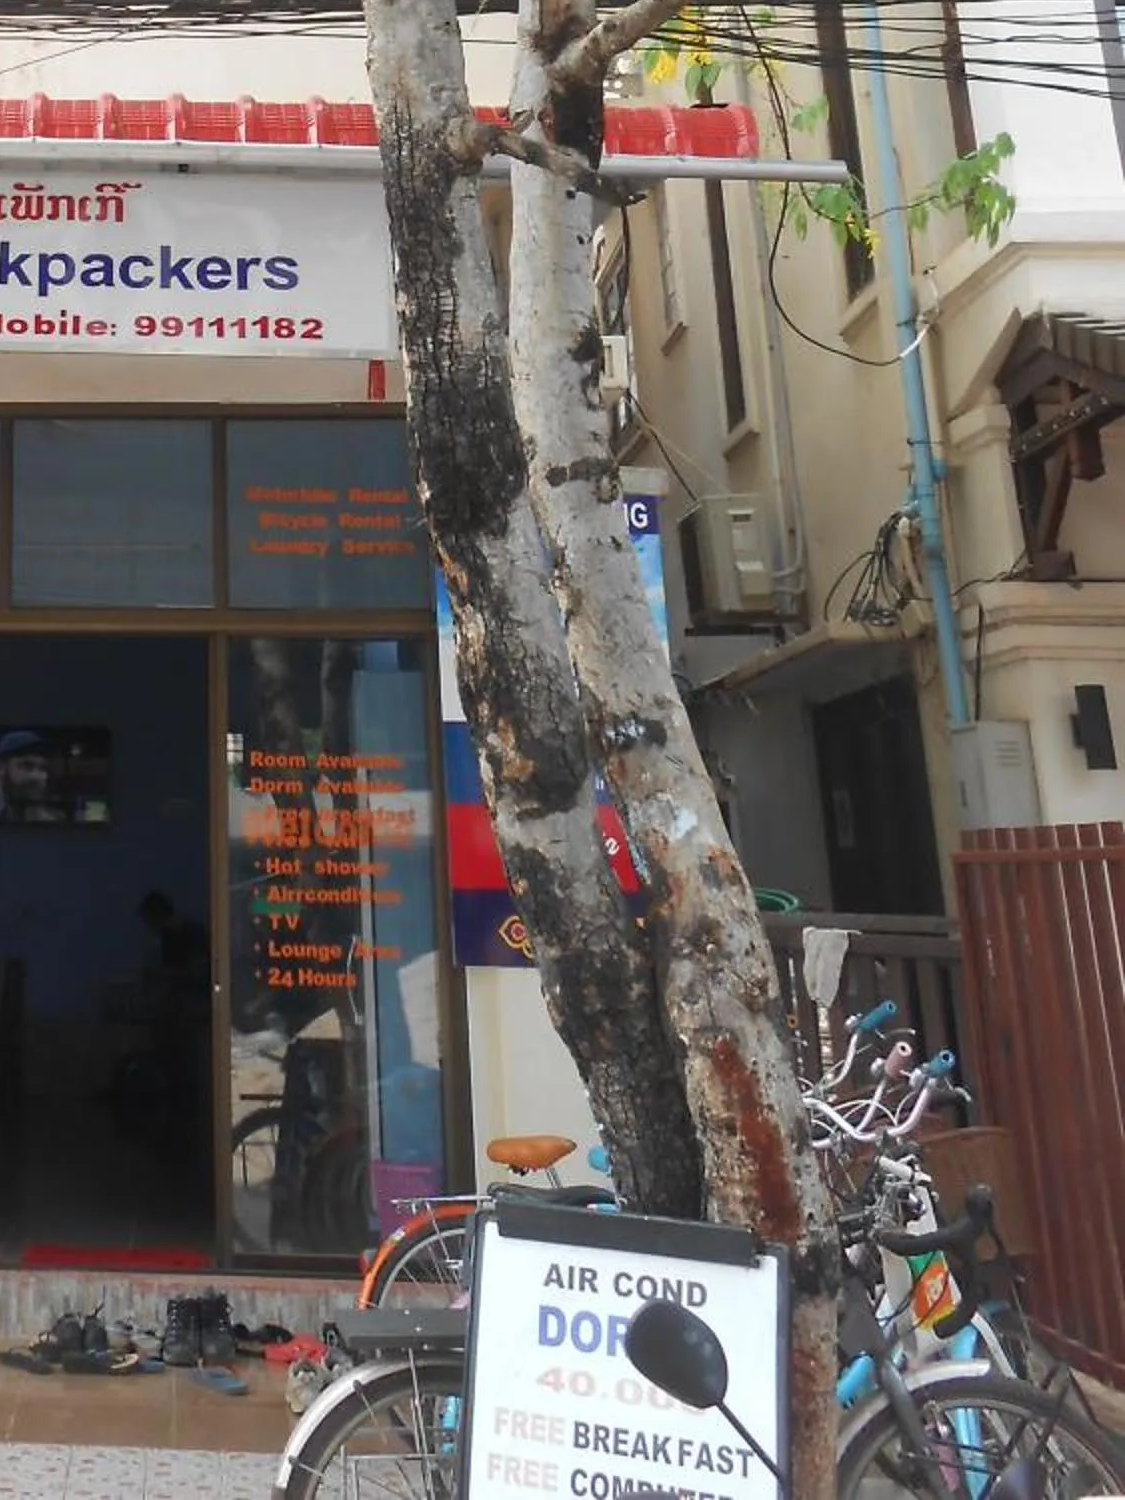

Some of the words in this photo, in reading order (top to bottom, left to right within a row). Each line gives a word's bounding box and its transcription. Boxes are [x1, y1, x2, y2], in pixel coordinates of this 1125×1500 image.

[134, 315, 323, 340] 99111182
[250, 751, 306, 768] Room
[251, 777, 303, 794] Dorm
[266, 857, 301, 875] Hot
[268, 941, 343, 962] Lounge
[267, 970, 293, 987] 24
[298, 969, 357, 987] Hours
[543, 1263, 599, 1294] AIR
[613, 1271, 708, 1308] COND
[538, 1305, 631, 1358] DOR
[493, 1406, 566, 1447] FREE
[486, 1452, 560, 1493] FREE
